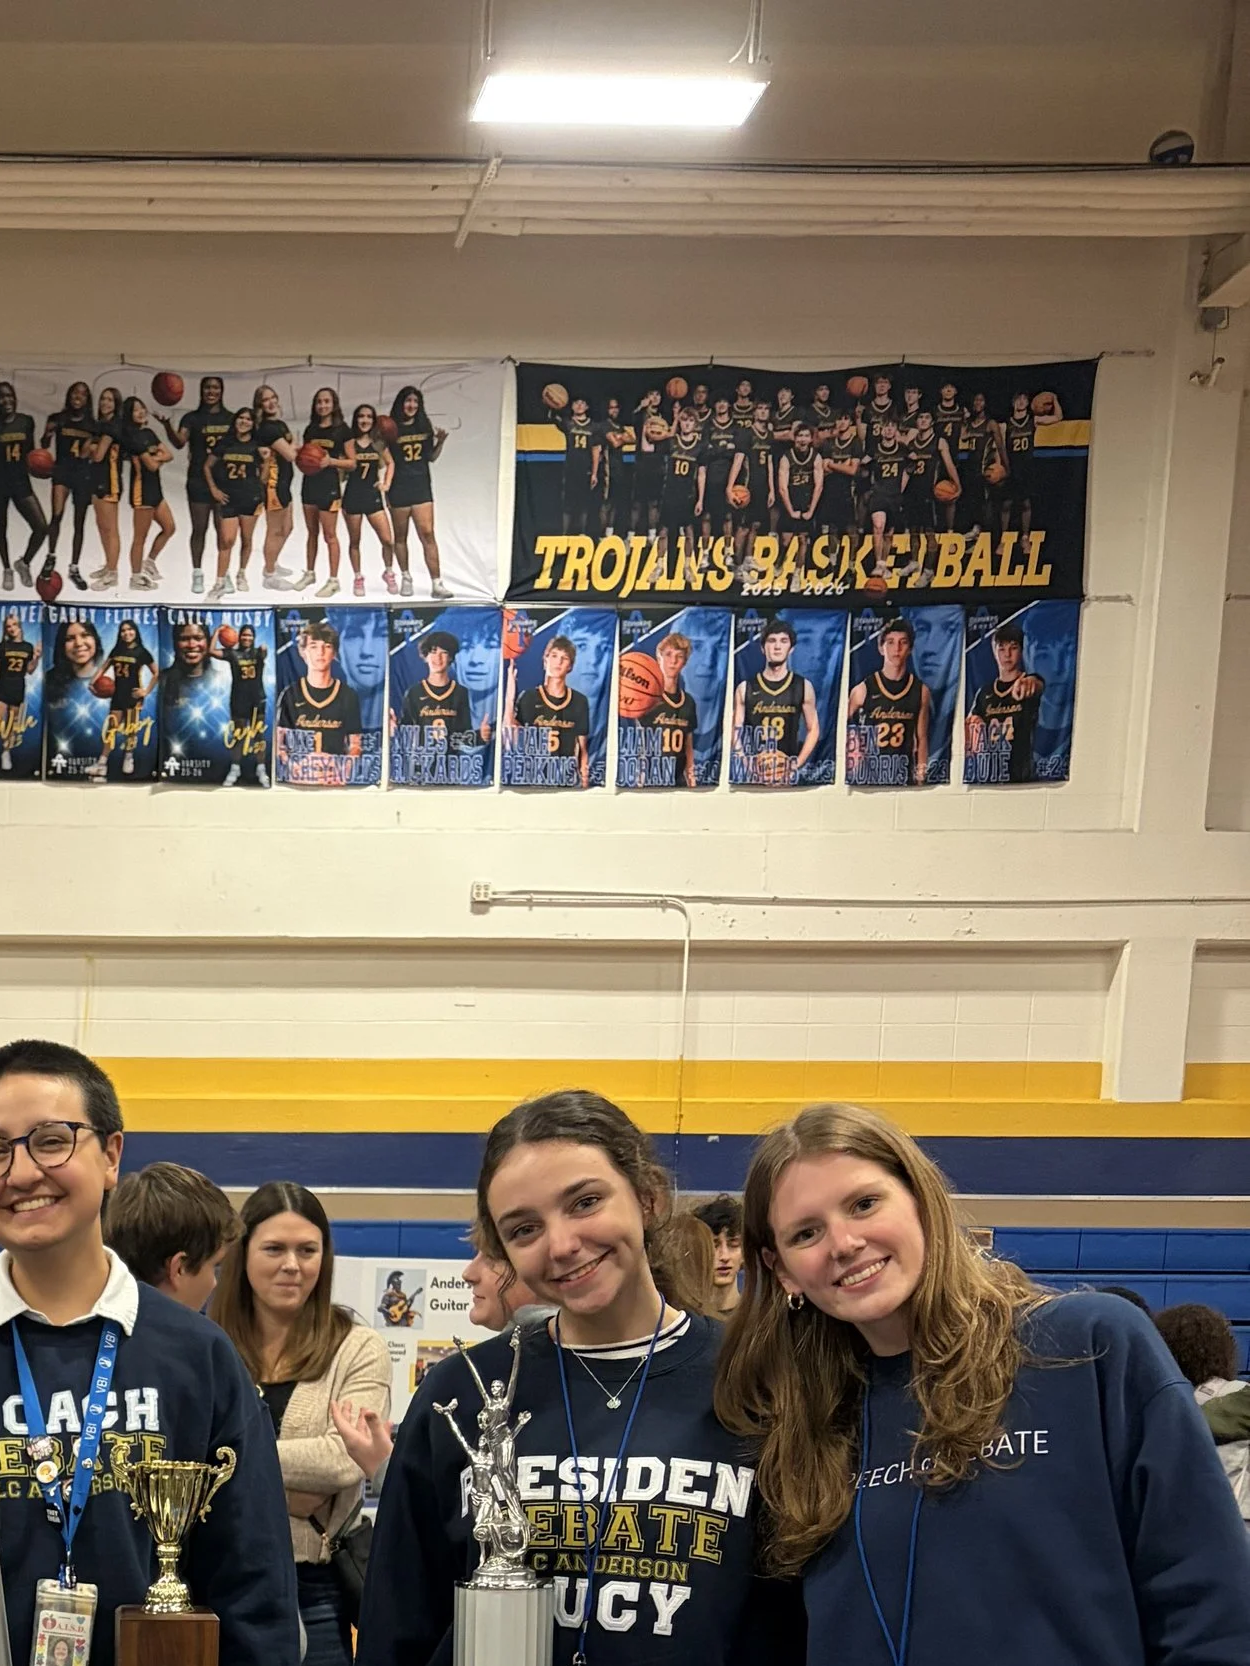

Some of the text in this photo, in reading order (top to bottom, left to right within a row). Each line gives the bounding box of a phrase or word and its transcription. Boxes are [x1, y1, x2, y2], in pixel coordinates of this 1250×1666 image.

[534, 530, 1052, 598] TROJANS BASKETBALL
[740, 581, 849, 597] 2025 2026
[49, 604, 160, 625] GABBY FLORES
[167, 608, 214, 627] CAYLA
[502, 724, 553, 755] NOAH
[618, 725, 663, 757] LIAM
[729, 724, 779, 754] ZACH
[846, 723, 881, 756] BEN
[964, 722, 1013, 754] JACK
[390, 754, 485, 786] RICKARDS
[502, 755, 578, 787] PERKINS
[617, 755, 678, 787] DORAN
[729, 754, 800, 785] WALLIS
[846, 753, 909, 785] BURRIS
[428, 1298, 471, 1312] Guitar
[95, 1376, 109, 1394] VBI
[84, 1422, 97, 1441] VBI
[979, 1430, 1049, 1460] BATE
[460, 1454, 756, 1519] PESIDEN
[853, 1459, 914, 1490] EECH
[512, 1501, 730, 1565] EBATE
[552, 1552, 691, 1584] ANDERSON
[553, 1575, 693, 1637] UCY
